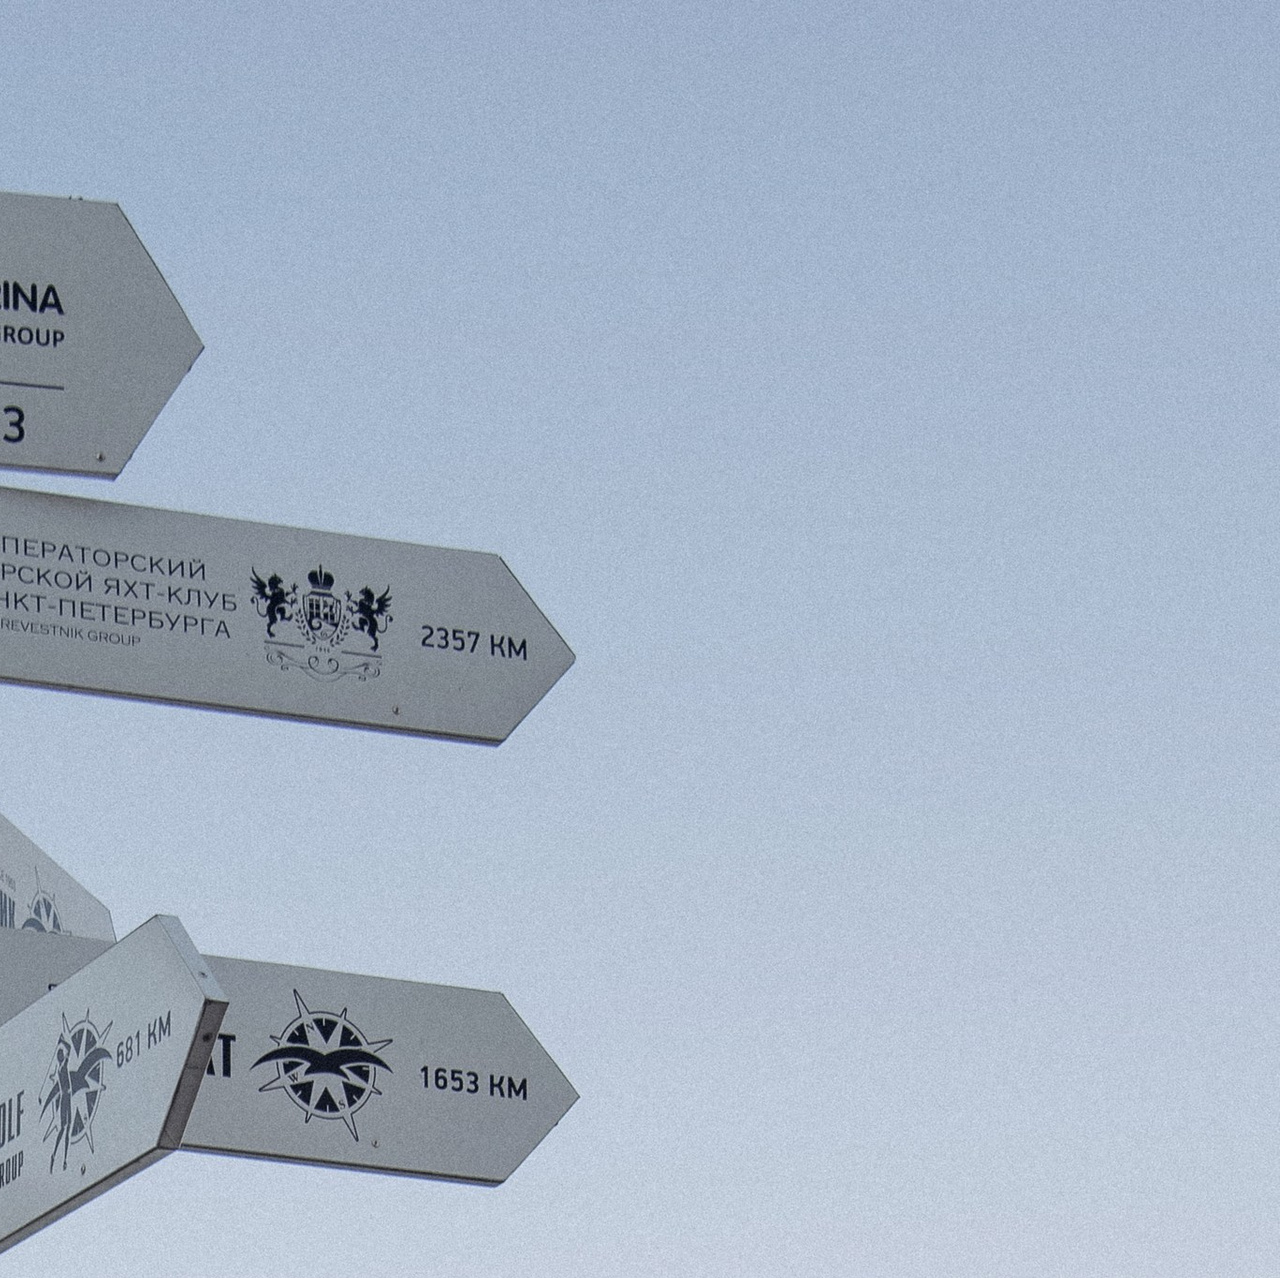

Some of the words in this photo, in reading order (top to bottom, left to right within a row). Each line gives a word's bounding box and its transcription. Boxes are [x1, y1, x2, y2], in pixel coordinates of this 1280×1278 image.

[103, 577, 238, 612] ЯХТ-КЛУБ
[86, 629, 141, 647] GROUP
[421, 624, 480, 653] 2357
[116, 1029, 141, 1069] 681
[420, 1065, 480, 1094] 1653
